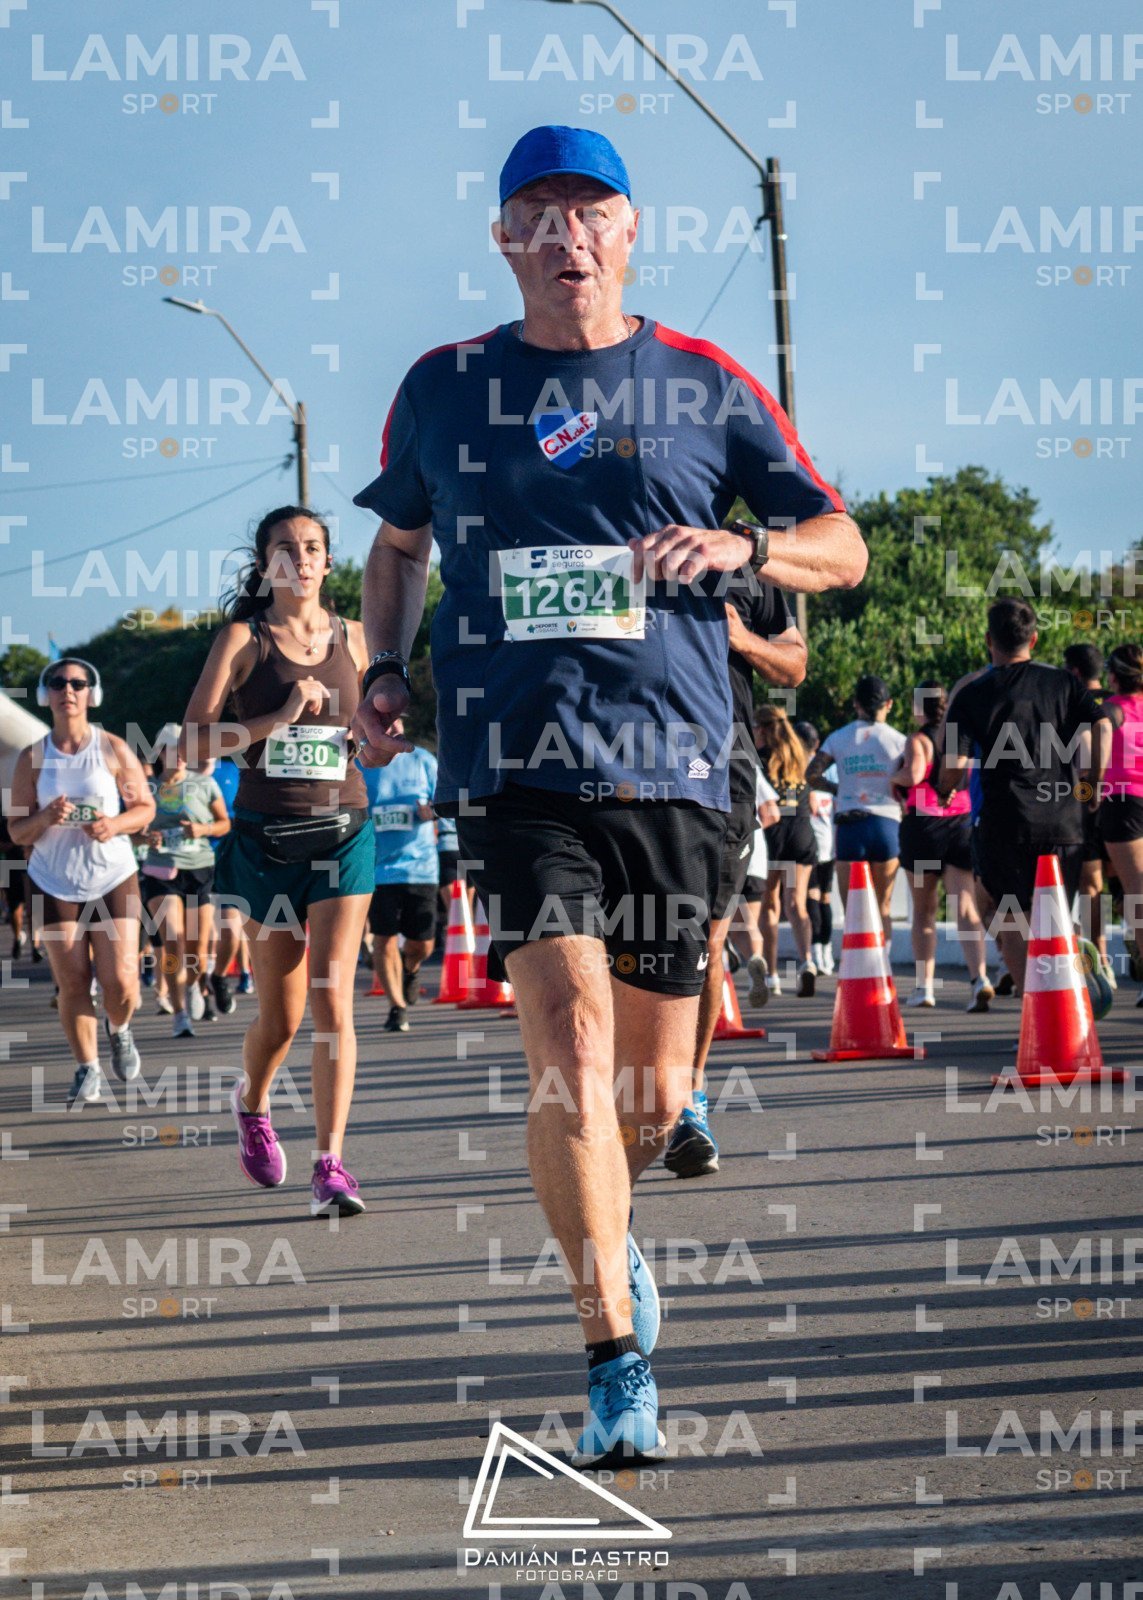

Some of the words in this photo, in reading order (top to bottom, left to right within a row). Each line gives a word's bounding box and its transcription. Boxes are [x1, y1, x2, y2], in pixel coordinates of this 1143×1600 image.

[552, 549, 593, 559] surco
[516, 578, 616, 616] 1264
[283, 743, 328, 765] 980
[66, 807, 92, 821] 88
